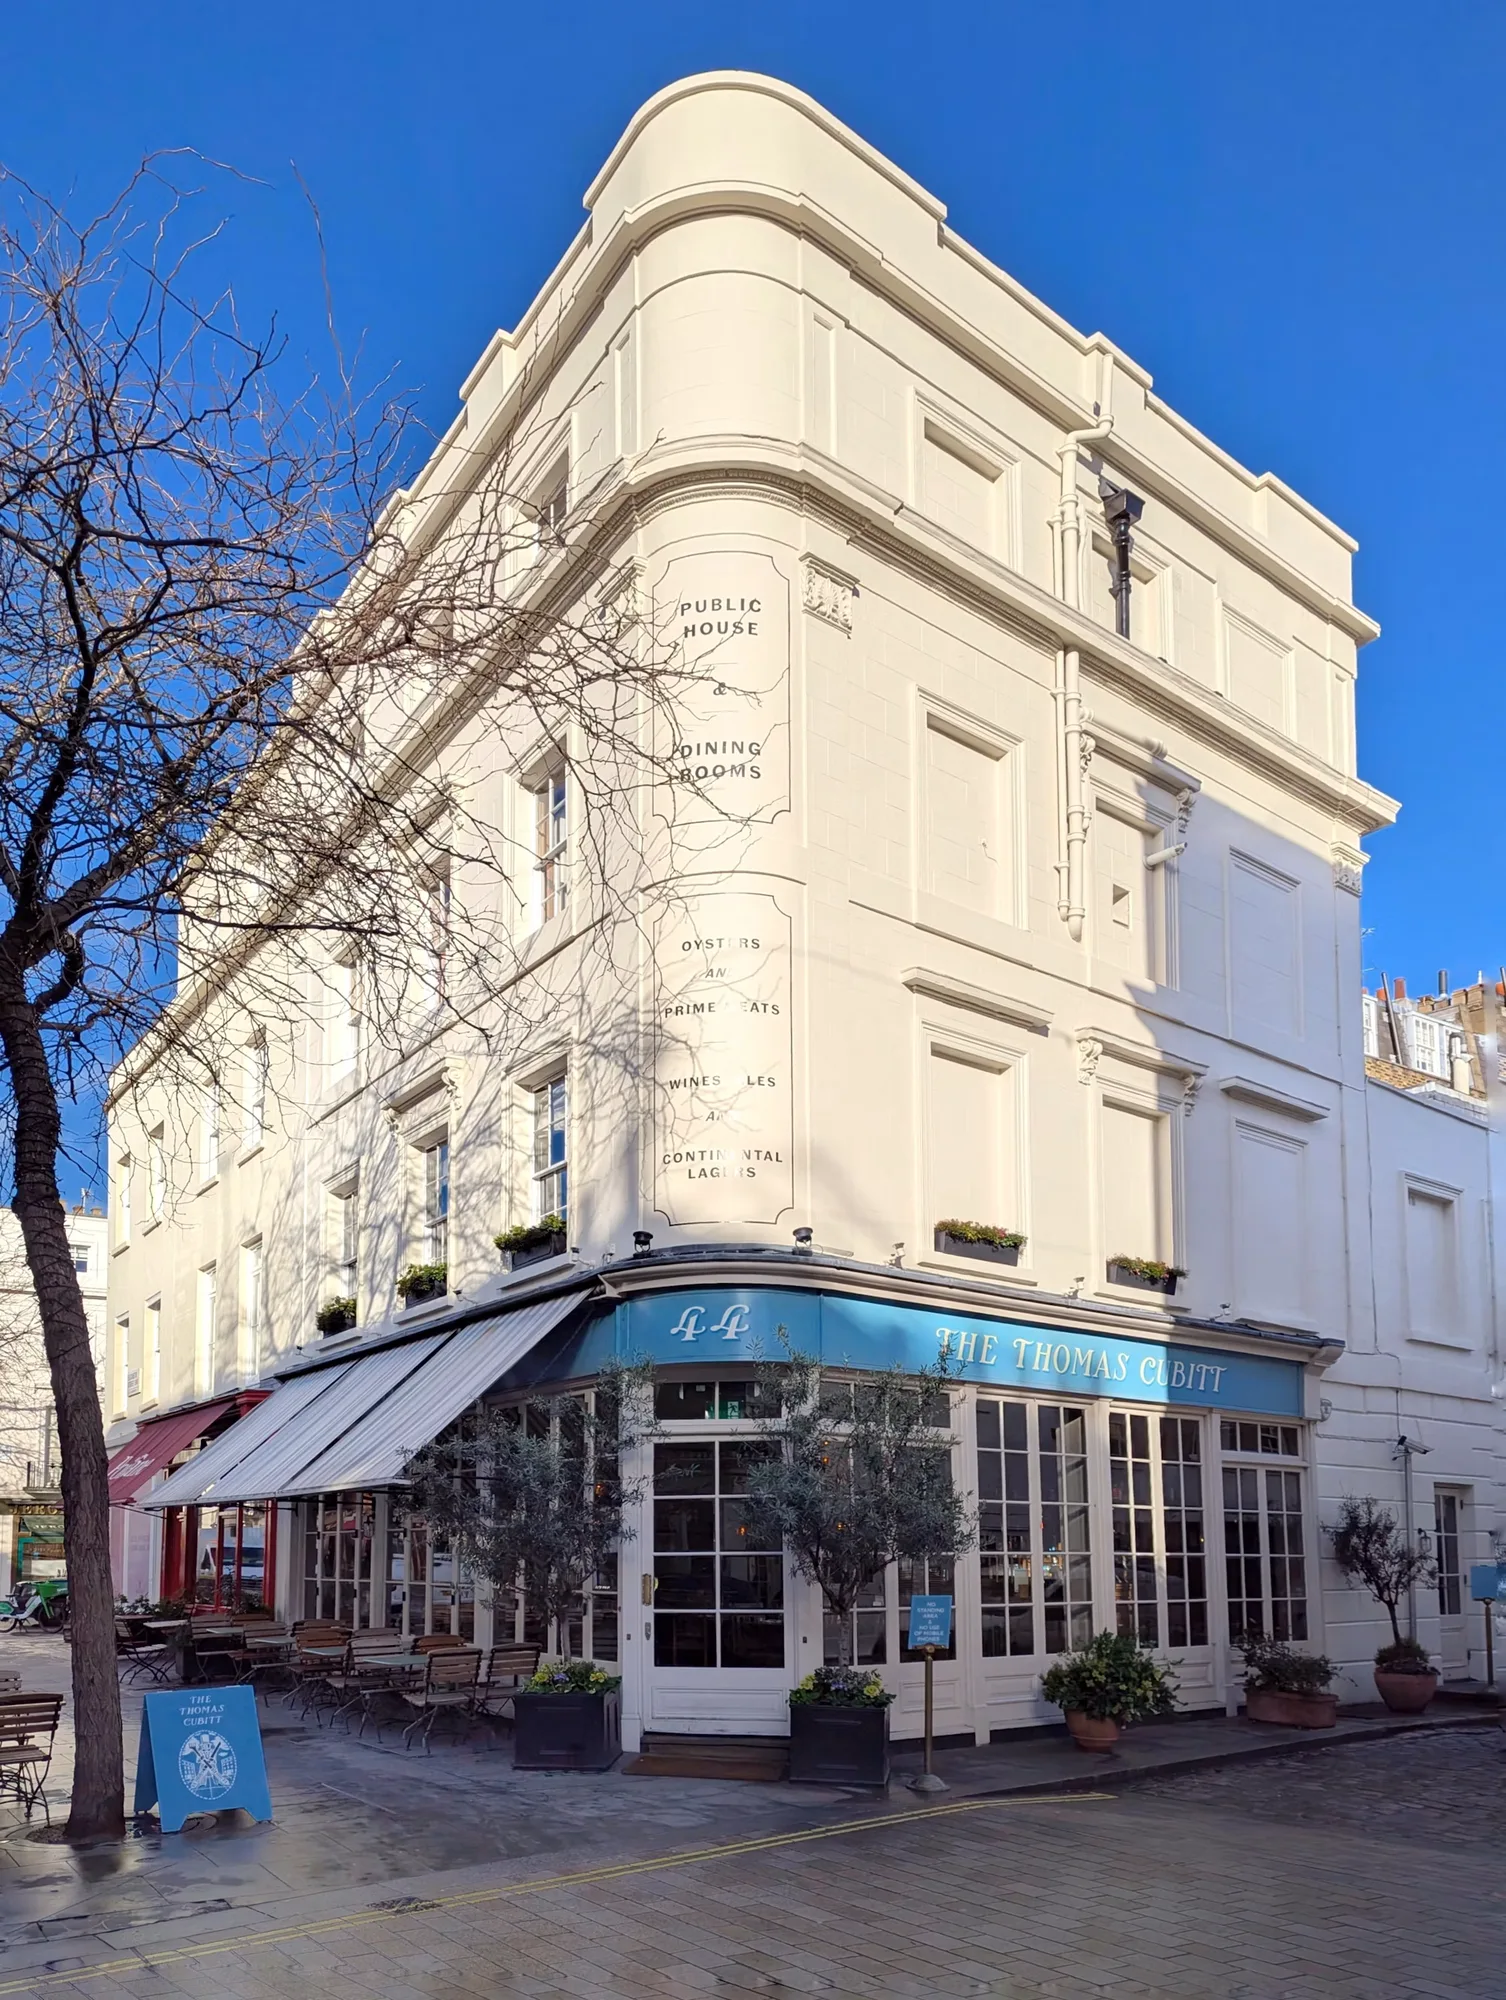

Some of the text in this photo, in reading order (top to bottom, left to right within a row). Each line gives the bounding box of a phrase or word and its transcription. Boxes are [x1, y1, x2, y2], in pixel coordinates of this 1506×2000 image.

[680, 598, 762, 616] PUBLIC
[683, 621, 758, 638] HOUSE
[712, 682, 727, 696] &
[680, 740, 761, 758] DINING
[680, 764, 762, 781] ROOMS
[705, 968, 732, 979] AN
[664, 1002, 780, 1018] PRIME EATS
[669, 1075, 776, 1090] WINES LES
[662, 1150, 783, 1165] CONTINNTAL
[688, 1167, 757, 1179] LAGS
[670, 1304, 750, 1341] 44
[935, 1328, 1228, 1393] THE THOMAS CUBITT
[189, 1694, 212, 1704] THE
[179, 1704, 225, 1715] THOMAS
[183, 1715, 223, 1726] CUBITT
